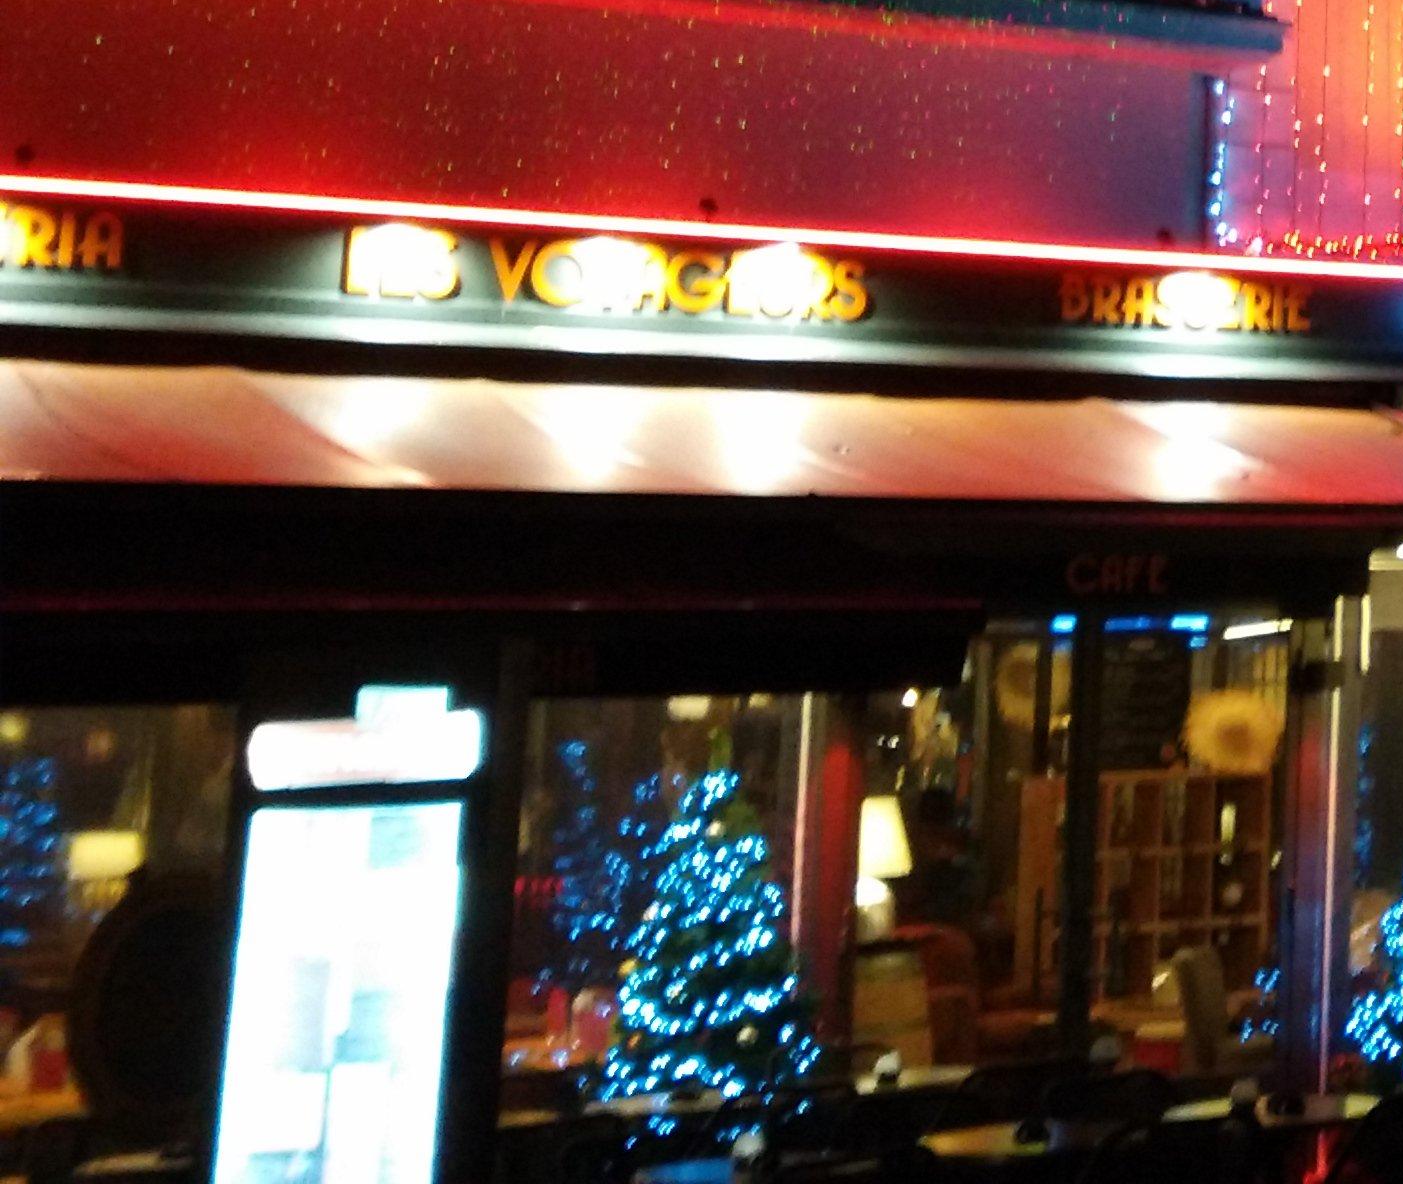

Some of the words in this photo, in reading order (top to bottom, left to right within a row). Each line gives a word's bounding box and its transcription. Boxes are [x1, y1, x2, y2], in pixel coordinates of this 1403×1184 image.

[0, 202, 124, 268] RIA
[346, 224, 461, 300] LS
[488, 232, 870, 321] VOAGERS
[1060, 273, 1312, 331] BRAERIE
